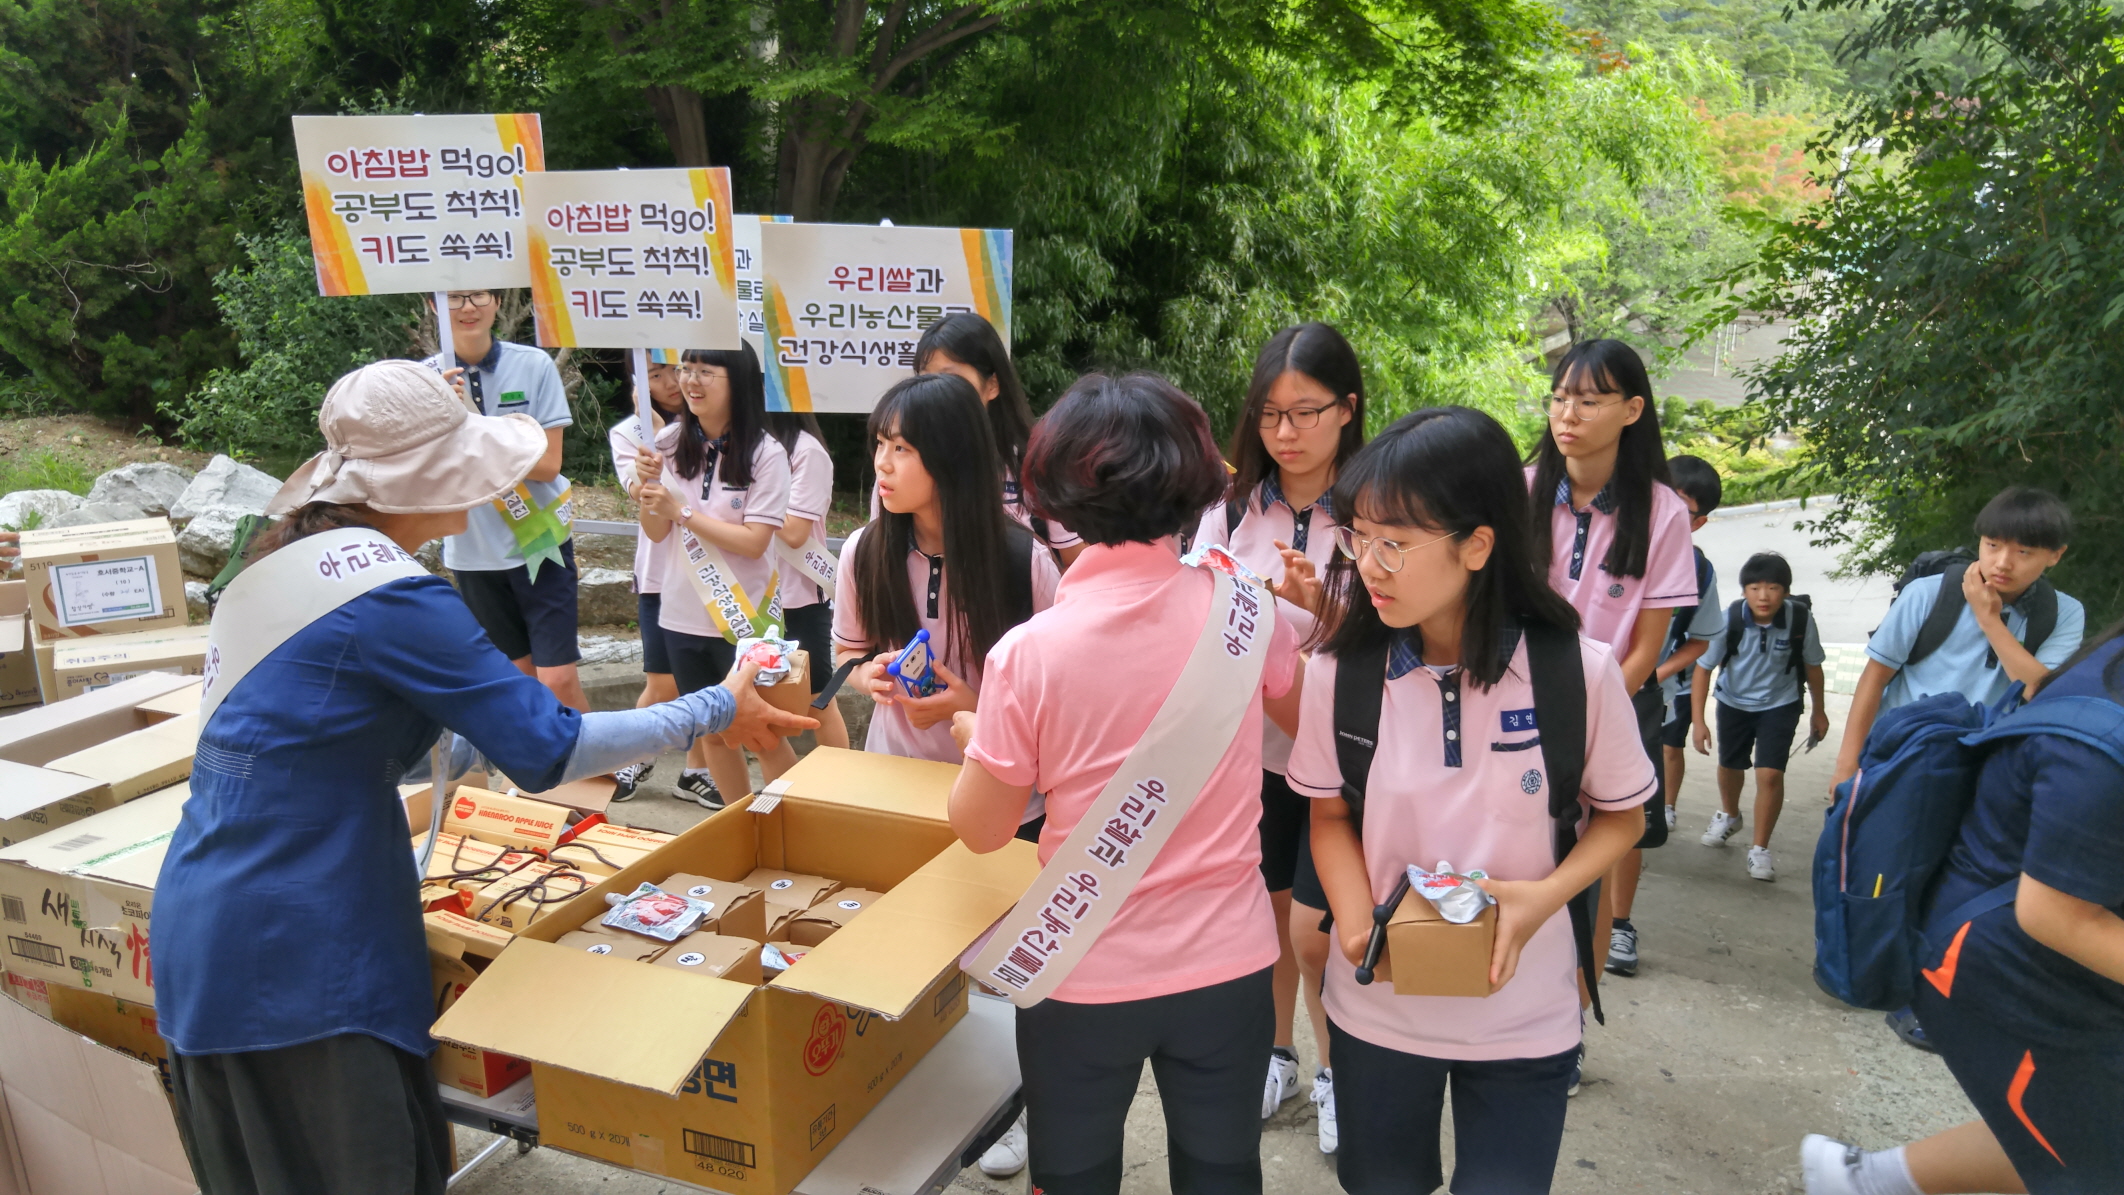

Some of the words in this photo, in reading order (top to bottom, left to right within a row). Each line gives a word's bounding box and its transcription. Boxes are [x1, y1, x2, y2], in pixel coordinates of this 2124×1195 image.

[327, 148, 431, 179] 아침밥
[440, 147, 525, 179] 먹go!
[333, 192, 438, 224] 공부도
[445, 188, 521, 219] 척척!
[547, 203, 630, 234] 아침밥
[640, 200, 716, 235] 먹go!
[361, 235, 431, 265] 키도
[440, 230, 514, 261] 쑥쑥!
[550, 246, 636, 277] 공부도
[643, 244, 710, 276] 척척!
[828, 265, 945, 294] 우리쌀과
[572, 290, 629, 320] 키도
[636, 289, 703, 319] 쑥쑥!
[515, 816, 534, 826] APPLE
[534, 820, 554, 830] JUICE
[1087, 779, 1167, 869] 우리쌀과
[42, 888, 70, 927] 새
[992, 872, 1100, 990] 우리농산물로
[811, 1025, 841, 1065] 오뚜기
[567, 1121, 586, 1136] 500
[696, 1161, 714, 1172] 48
[718, 1166, 745, 1180] 020
